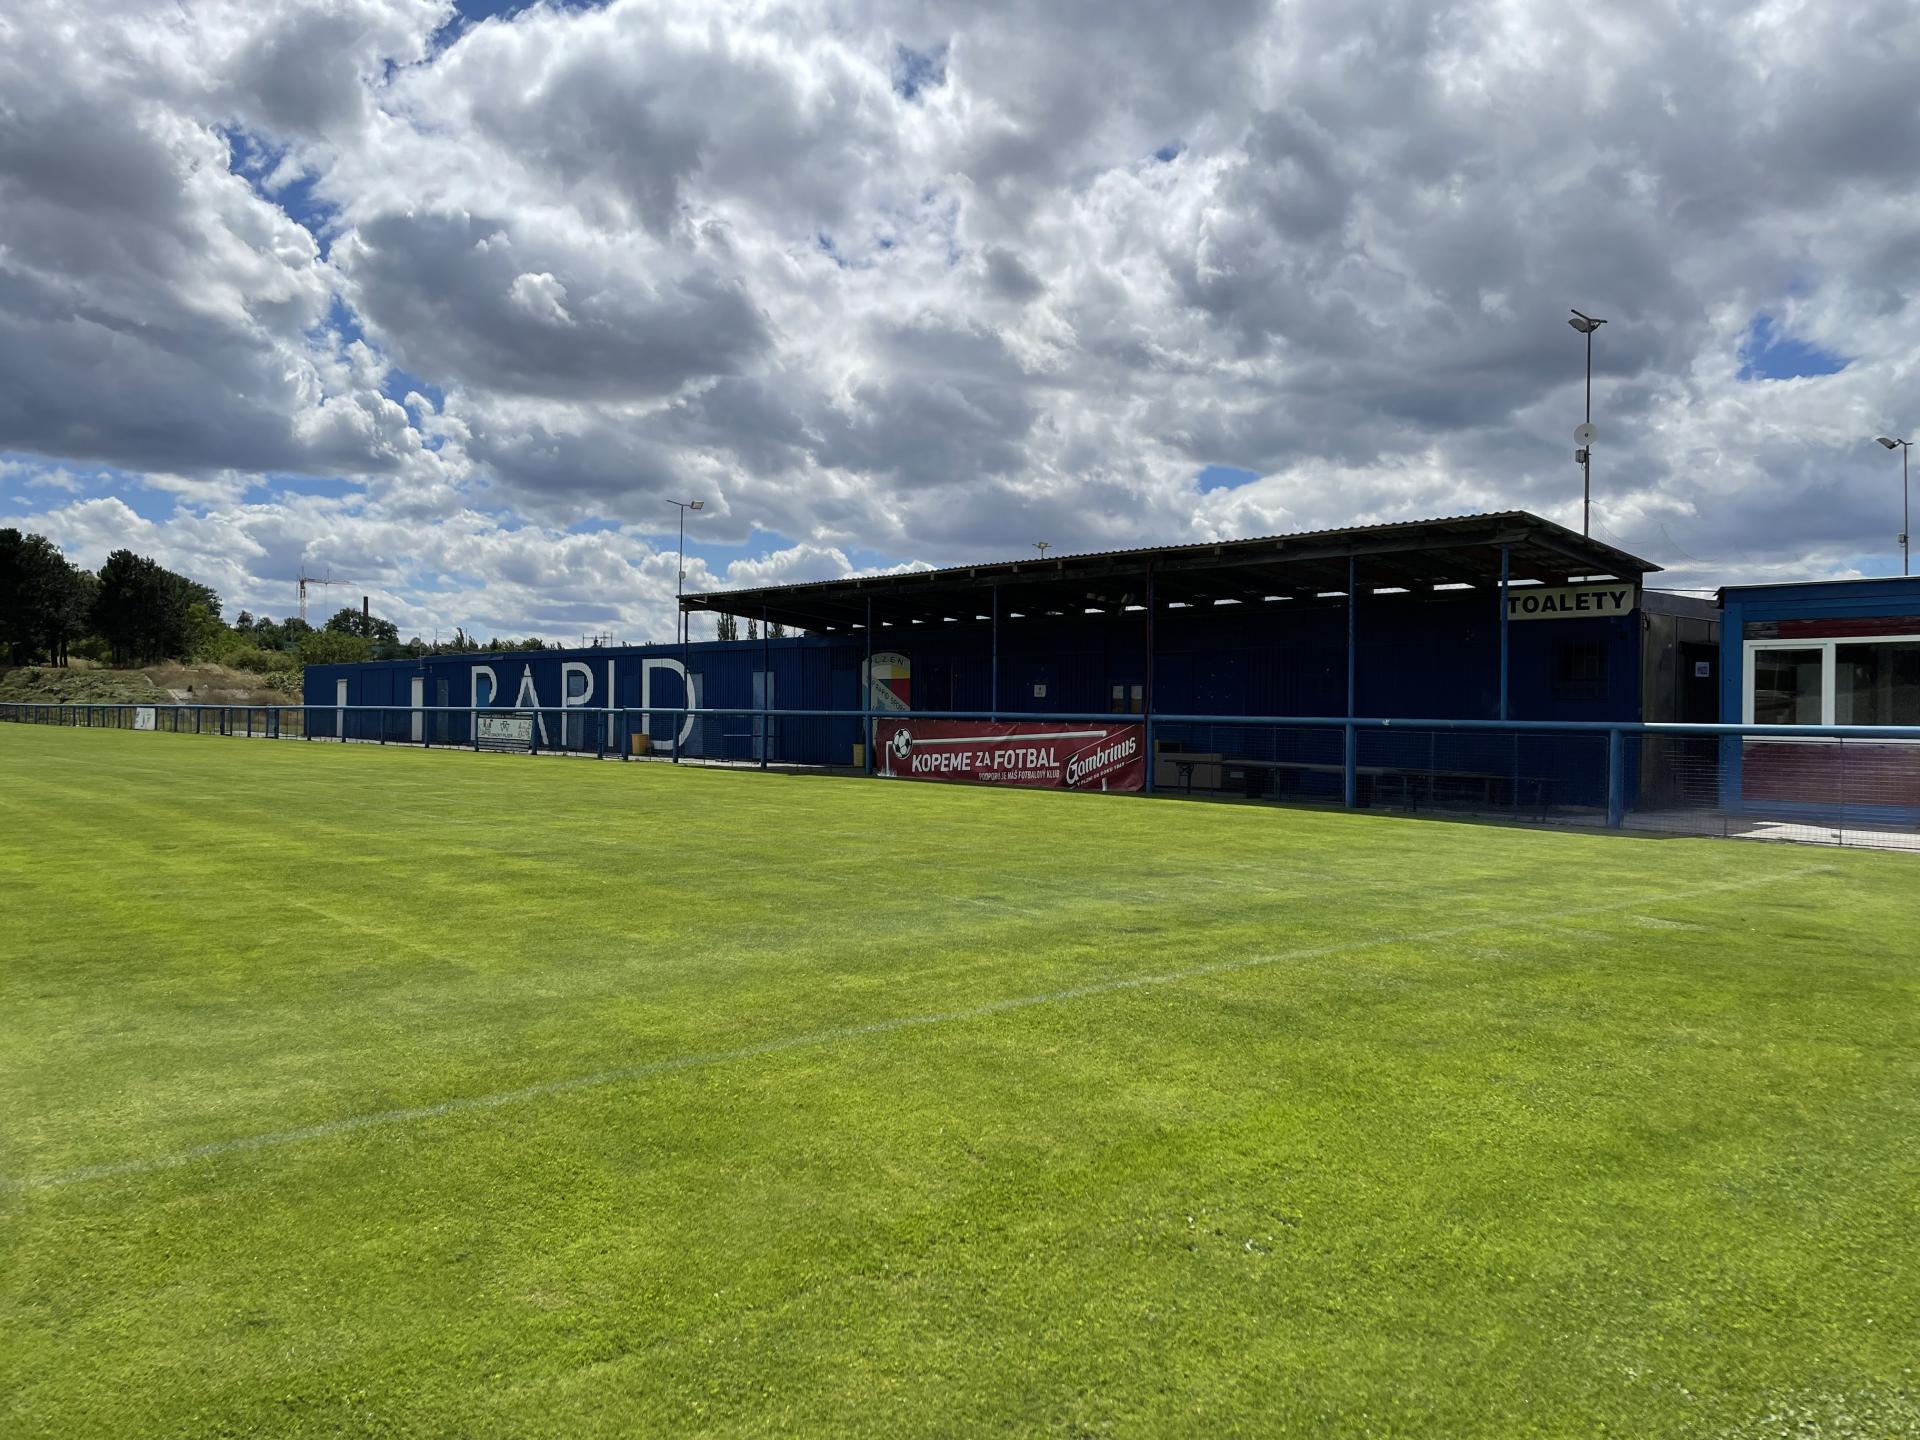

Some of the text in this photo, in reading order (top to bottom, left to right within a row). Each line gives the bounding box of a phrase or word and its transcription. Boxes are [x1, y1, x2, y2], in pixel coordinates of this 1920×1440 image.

[1507, 591, 1627, 614] TOALETY
[911, 747, 1060, 773] KOPEME ZA FOTBAL
[1066, 737, 1136, 785] Gambrinus
[1018, 768, 1046, 779] FOTBALOVÝ
[1046, 769, 1060, 779] KLUB
